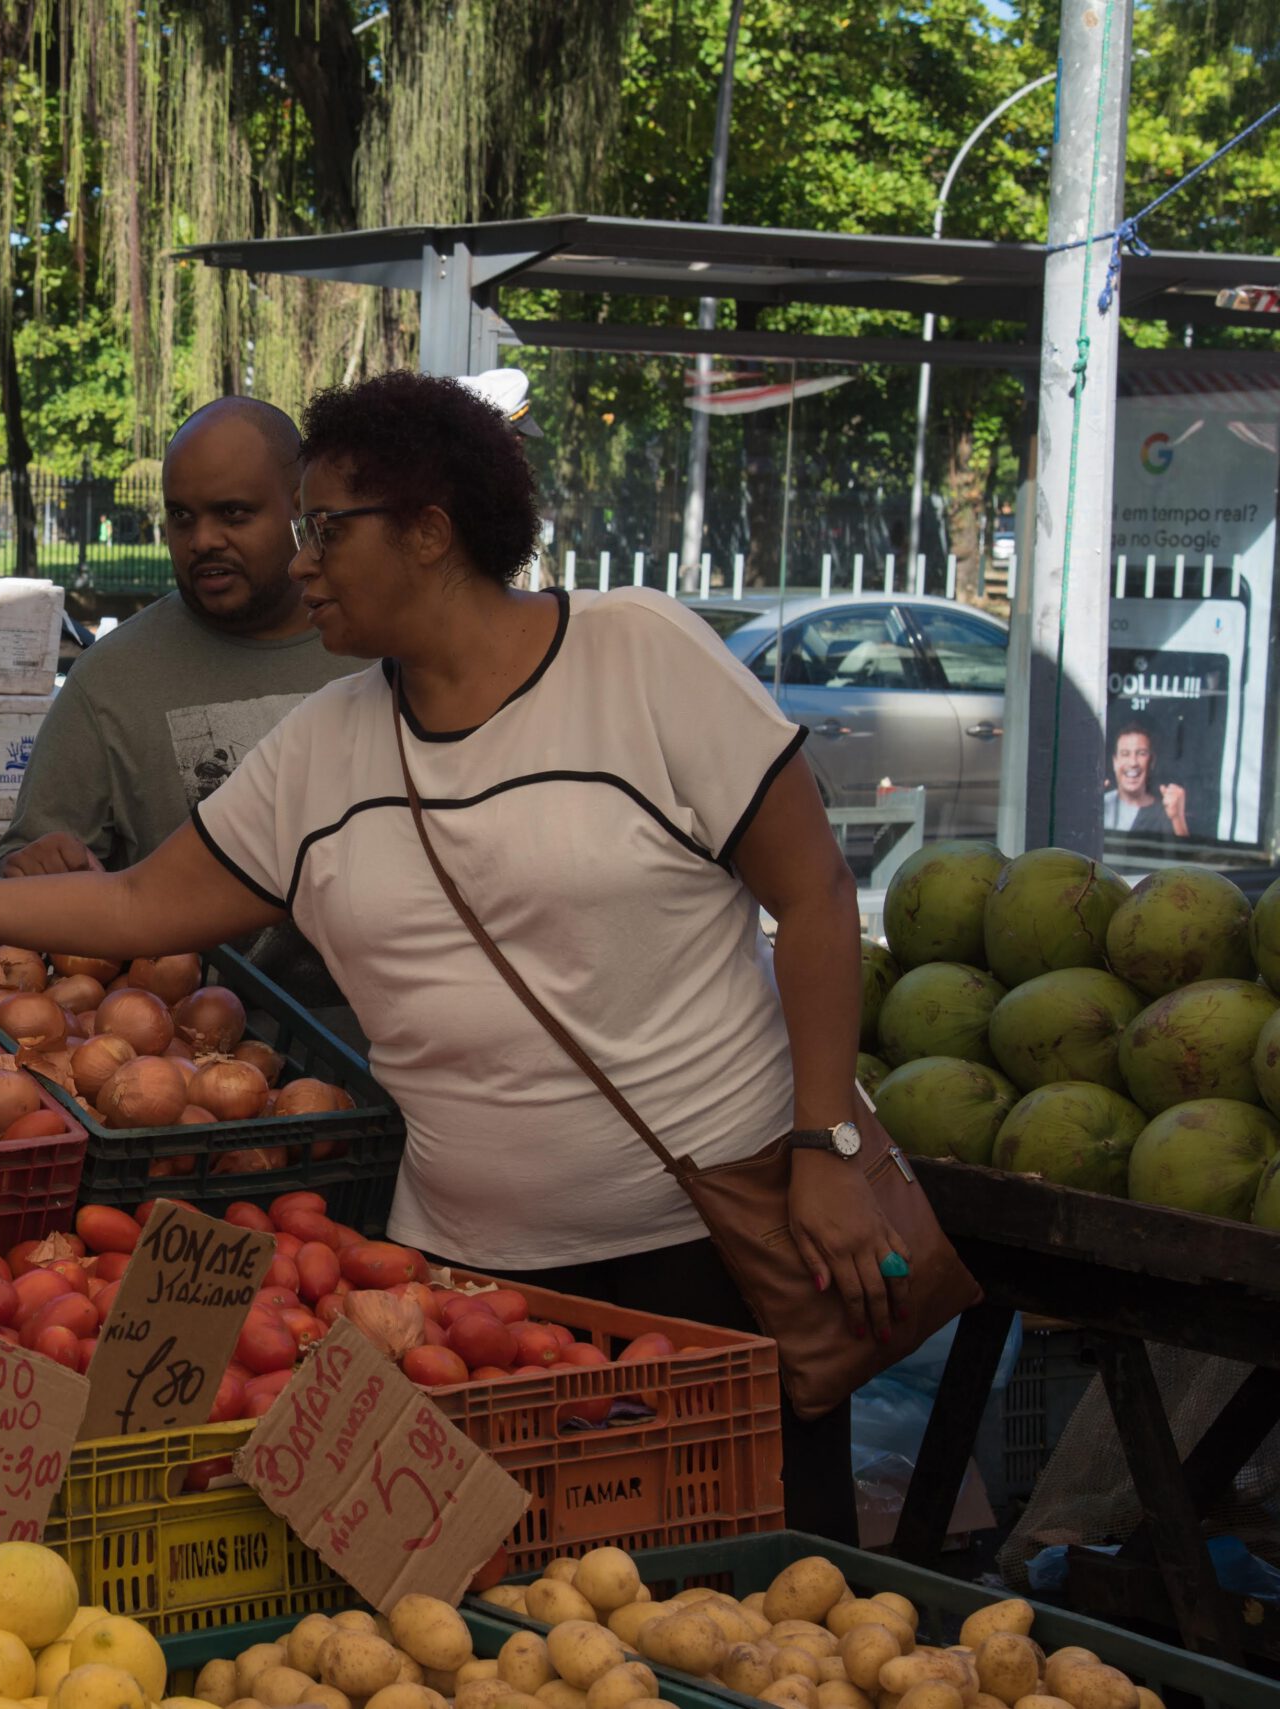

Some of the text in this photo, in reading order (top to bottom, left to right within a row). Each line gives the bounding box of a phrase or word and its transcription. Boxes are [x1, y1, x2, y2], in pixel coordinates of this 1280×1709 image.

[1122, 507, 1148, 522] em
[1153, 505, 1210, 525] tempo
[1214, 504, 1258, 522] real?
[1131, 533, 1150, 547] no
[1154, 530, 1221, 551] Google
[255, 1345, 353, 1497] BATATA
[565, 1477, 642, 1510] ITAMAR
[169, 1531, 269, 1582] MINAS RIO
